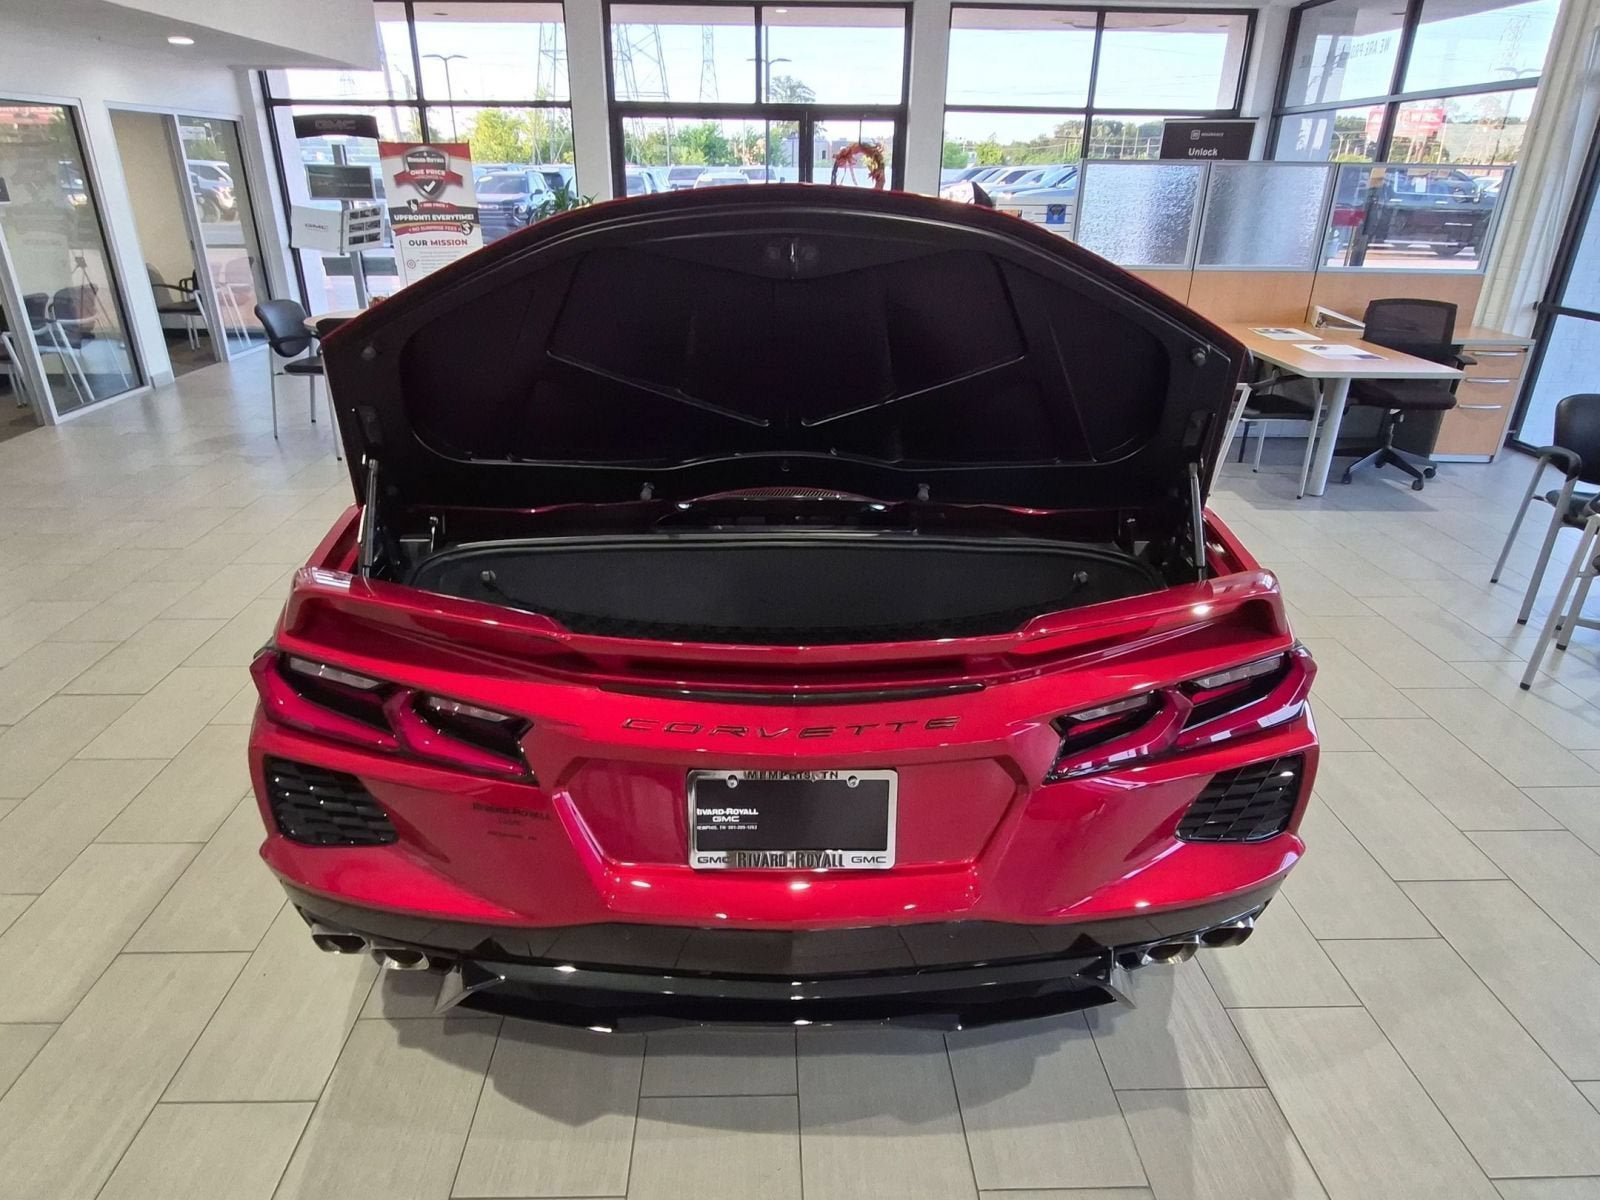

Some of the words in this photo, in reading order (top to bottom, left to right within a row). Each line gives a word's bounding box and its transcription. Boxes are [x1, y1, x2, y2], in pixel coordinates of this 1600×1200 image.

[314, 119, 356, 130] GMC
[1188, 147, 1218, 157] Unlock
[426, 168, 446, 176] PRICE
[393, 213, 431, 221] UPFRONT!
[408, 239, 428, 247] OUR
[621, 716, 962, 739] CORVETTE
[712, 815, 740, 823] GMC
[697, 855, 730, 864] GMC
[851, 855, 887, 864] GMC
